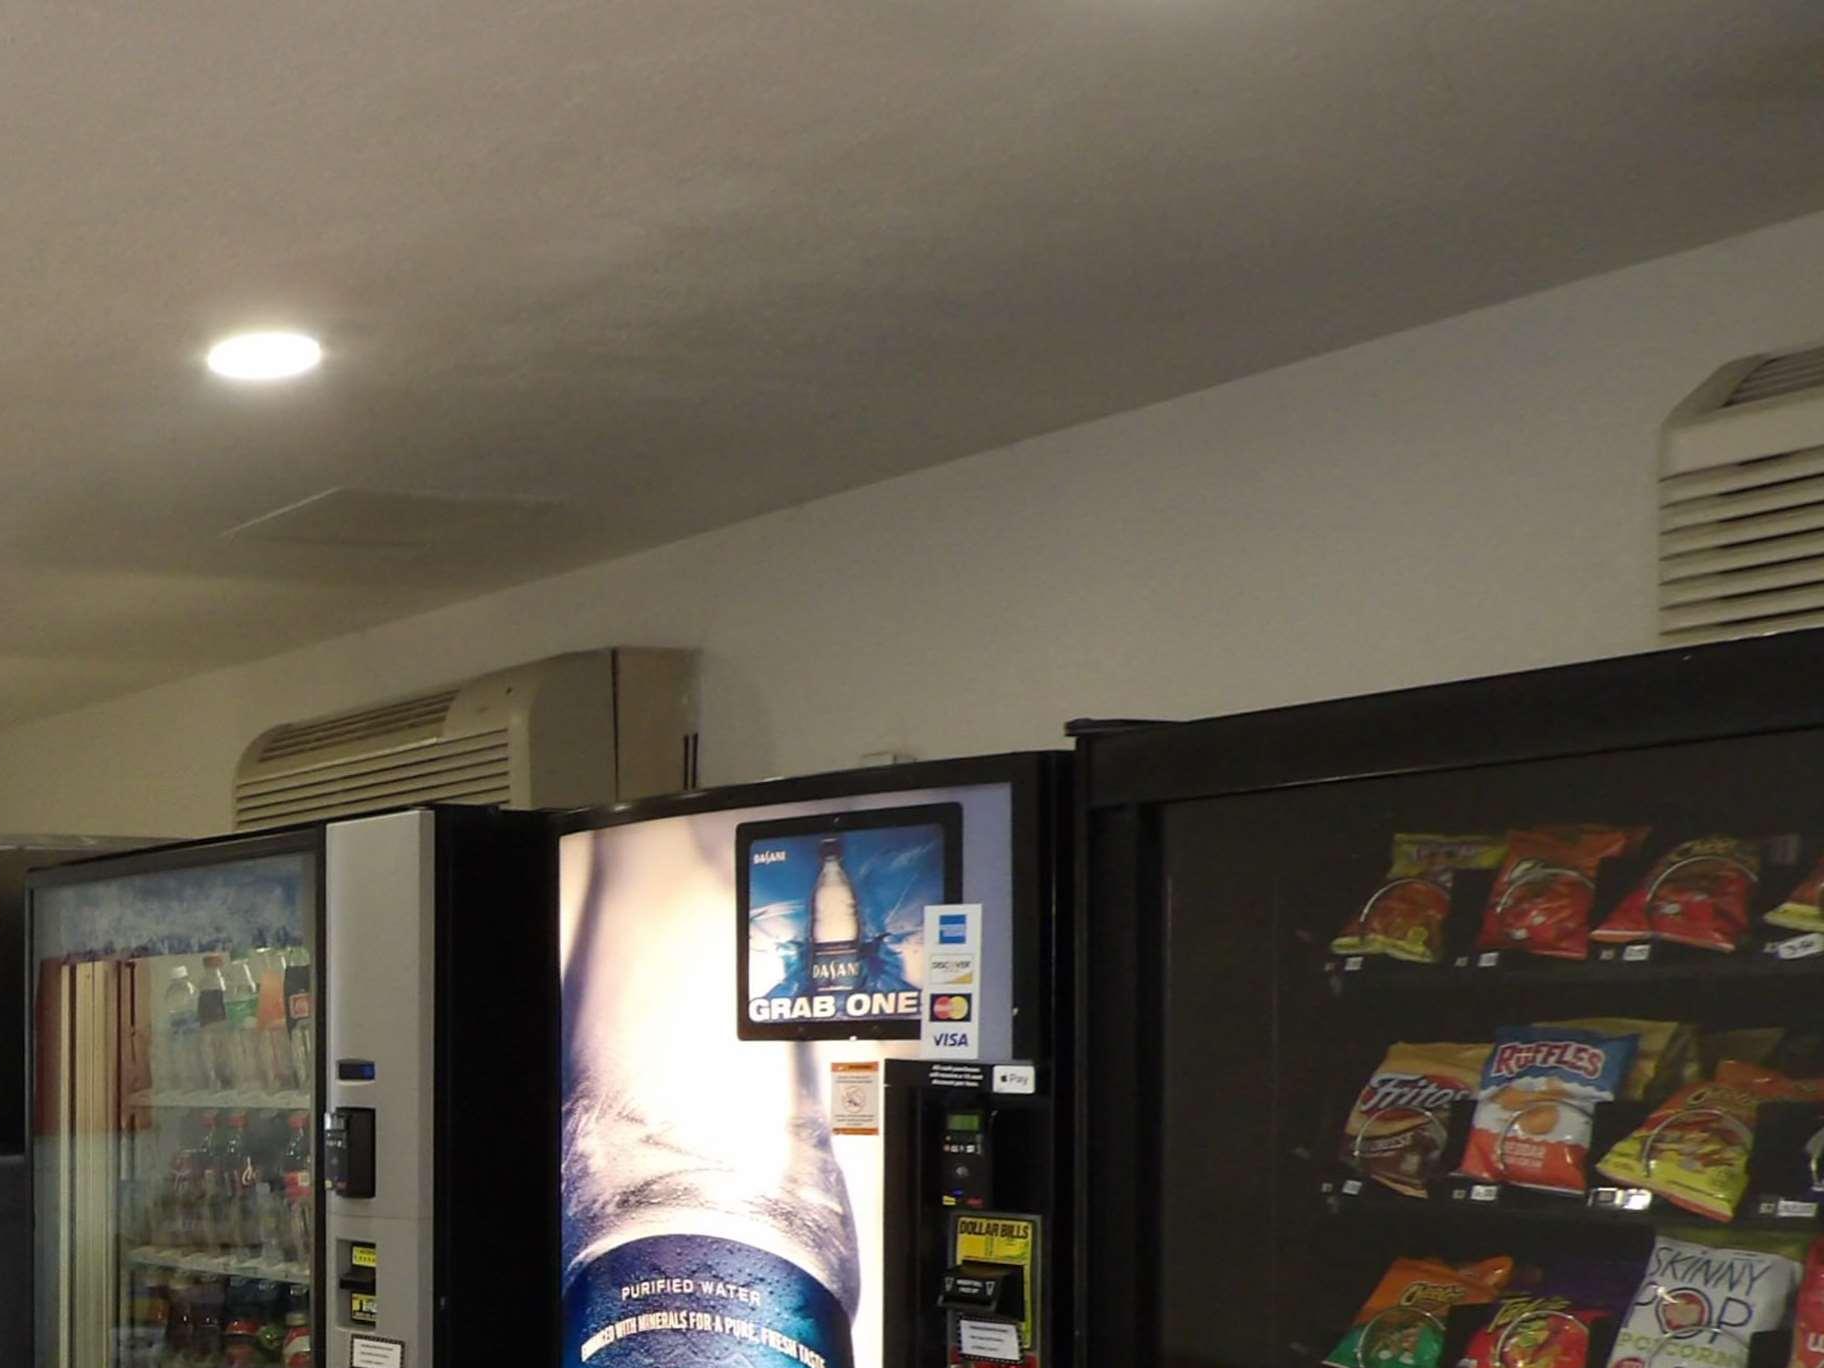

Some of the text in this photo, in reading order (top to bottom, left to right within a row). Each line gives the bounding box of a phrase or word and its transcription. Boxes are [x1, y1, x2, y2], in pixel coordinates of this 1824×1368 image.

[748, 992, 918, 1022] GRAB ONE
[934, 1033, 969, 1047] VISA
[1491, 1040, 1605, 1079] RUFFLES
[960, 1220, 1029, 1239] DOLLAR BILLS
[1648, 1246, 1772, 1296] SKINNY
[622, 1279, 761, 1306] PURIFIED WATER
[615, 1317, 637, 1340] WITH
[637, 1311, 687, 1332] MINERALS
[689, 1312, 712, 1331] FOR
[714, 1315, 723, 1332] A
[761, 1327, 798, 1358] FRESH
